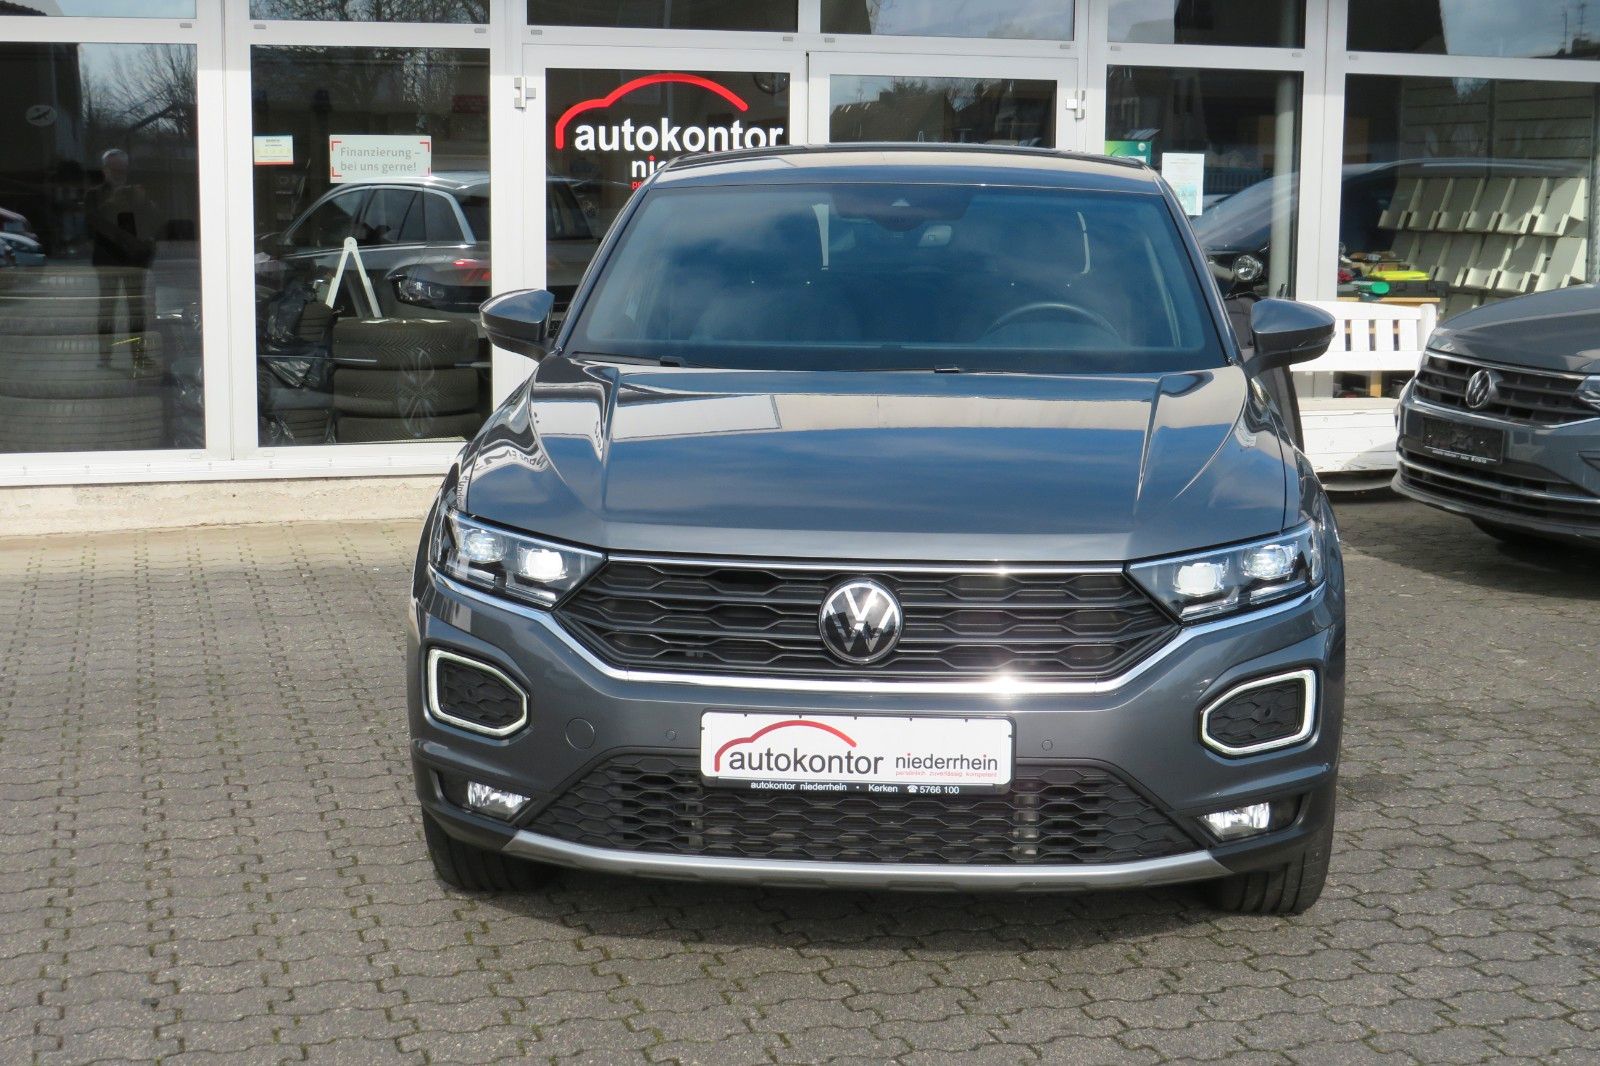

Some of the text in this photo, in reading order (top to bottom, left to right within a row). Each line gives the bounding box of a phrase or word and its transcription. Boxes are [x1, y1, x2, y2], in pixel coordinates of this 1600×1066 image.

[574, 118, 784, 151] autokontor
[340, 147, 412, 159] Finanzierung
[340, 161, 417, 174] bei uns gerne!
[729, 748, 998, 774] autokontor niederrhein
[750, 782, 960, 794] autokontor niederrhein Kerken 5766 100
